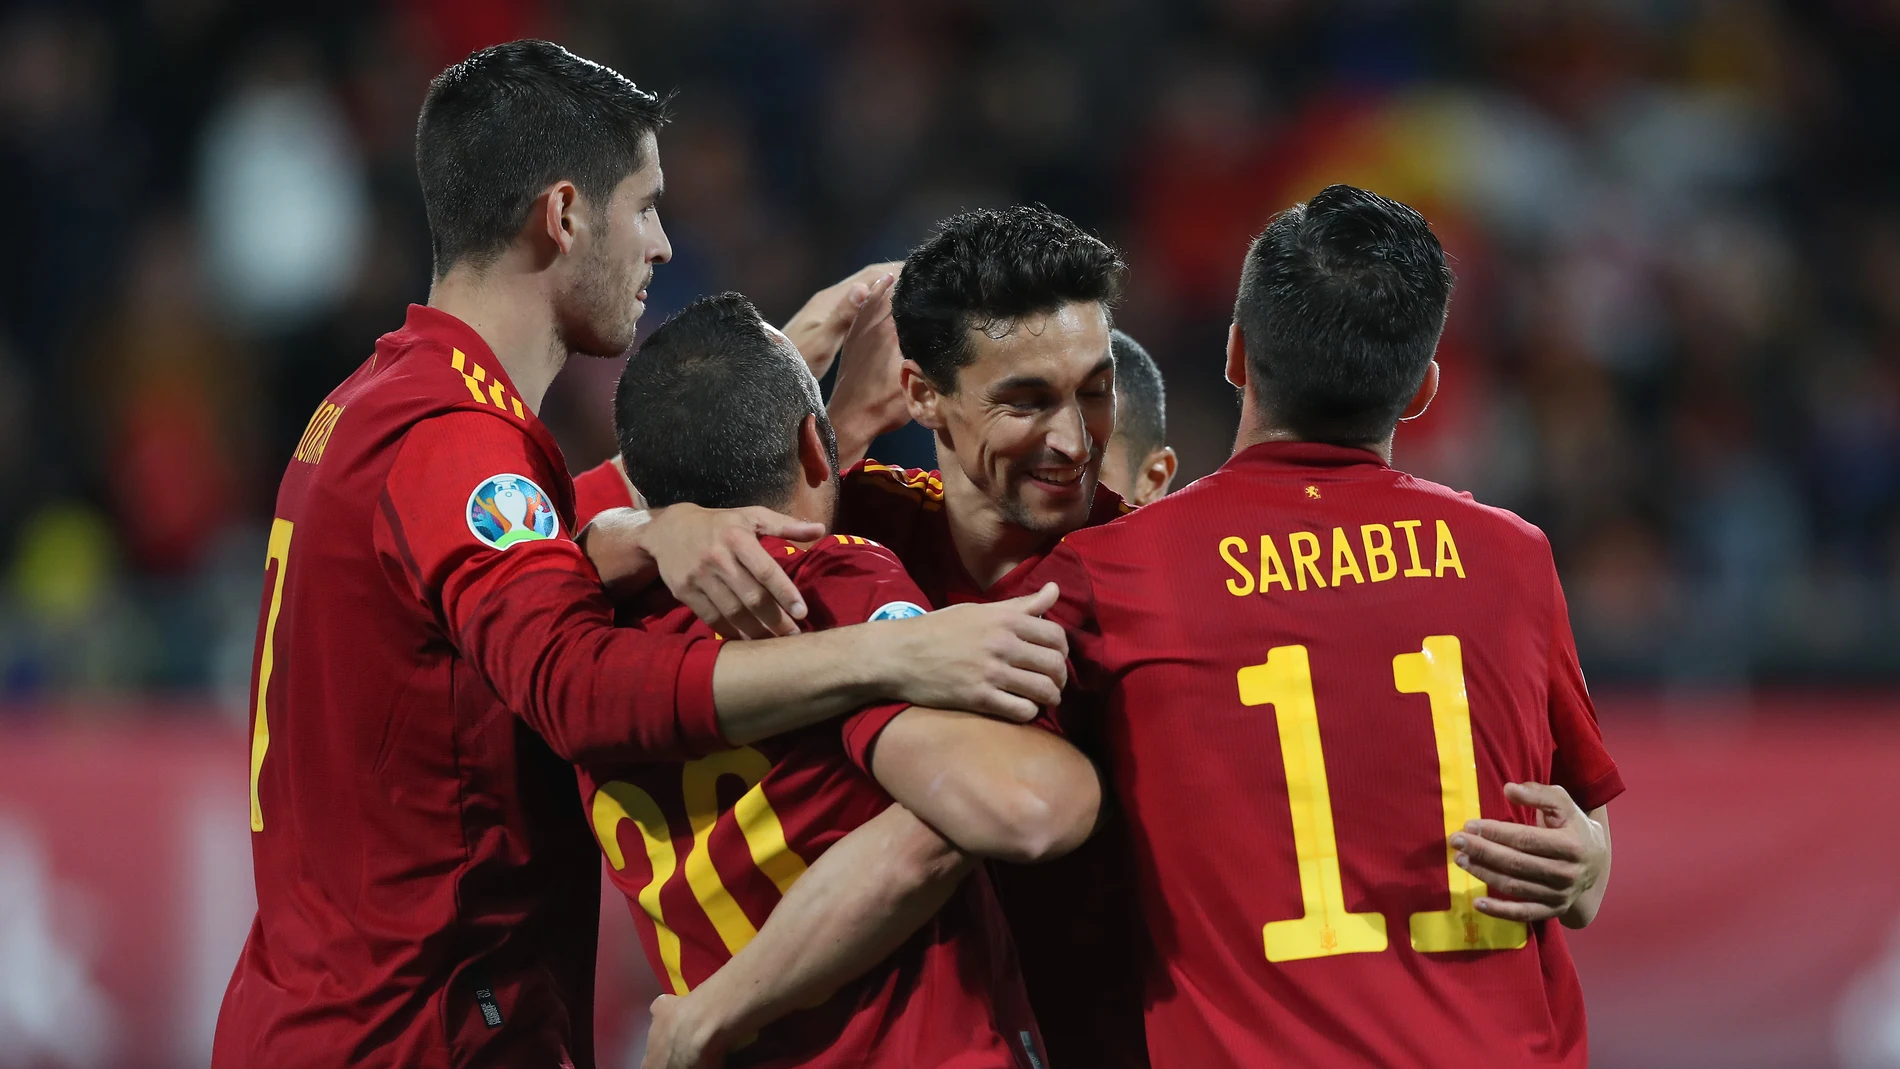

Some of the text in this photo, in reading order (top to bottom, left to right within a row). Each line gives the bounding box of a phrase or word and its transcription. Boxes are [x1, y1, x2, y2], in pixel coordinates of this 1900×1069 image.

[250, 517, 295, 833] 7
[1218, 519, 1466, 597] SARABIA
[592, 745, 809, 999] 20
[1236, 634, 1528, 963] 11
